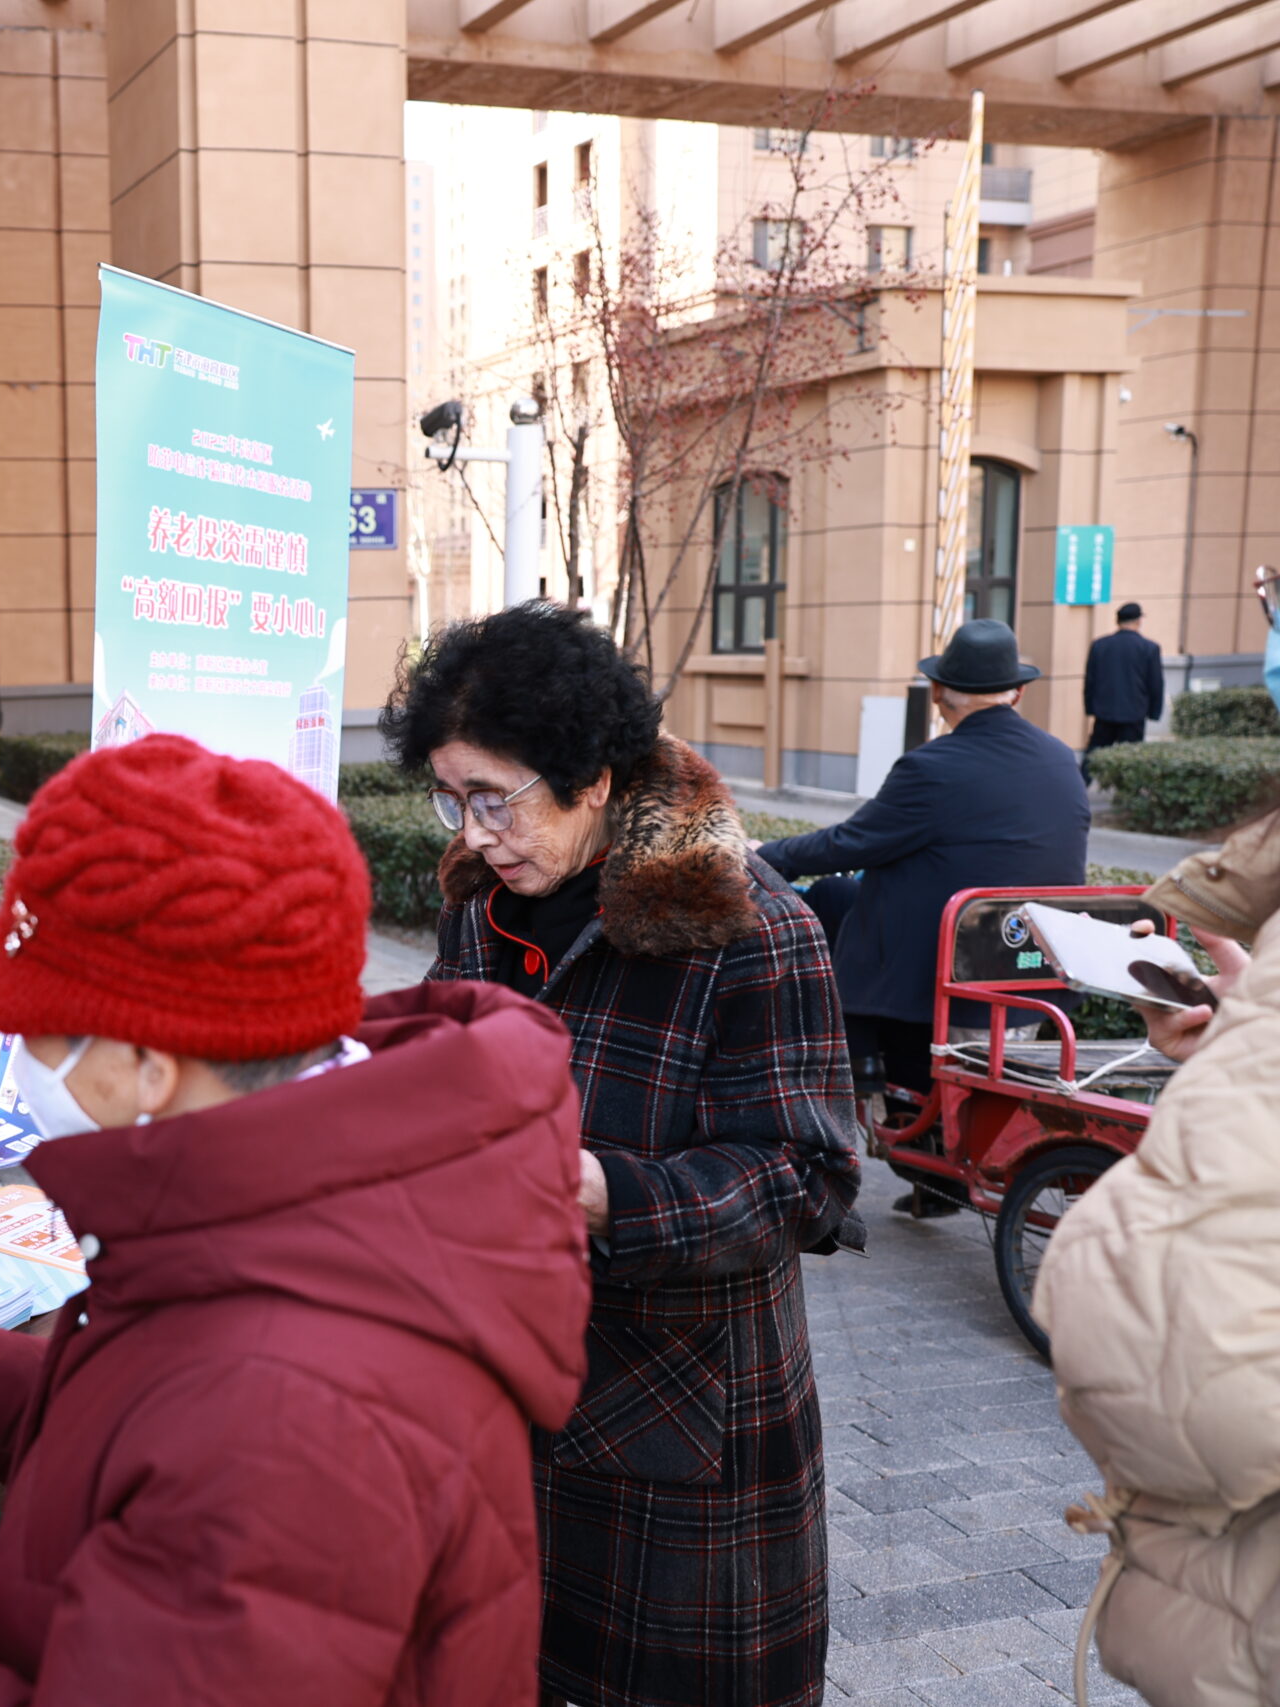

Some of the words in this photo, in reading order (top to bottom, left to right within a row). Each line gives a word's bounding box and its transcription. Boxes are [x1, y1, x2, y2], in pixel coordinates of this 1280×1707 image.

[123, 332, 172, 367] THT
[148, 506, 308, 575] 养老投资需谨慎
